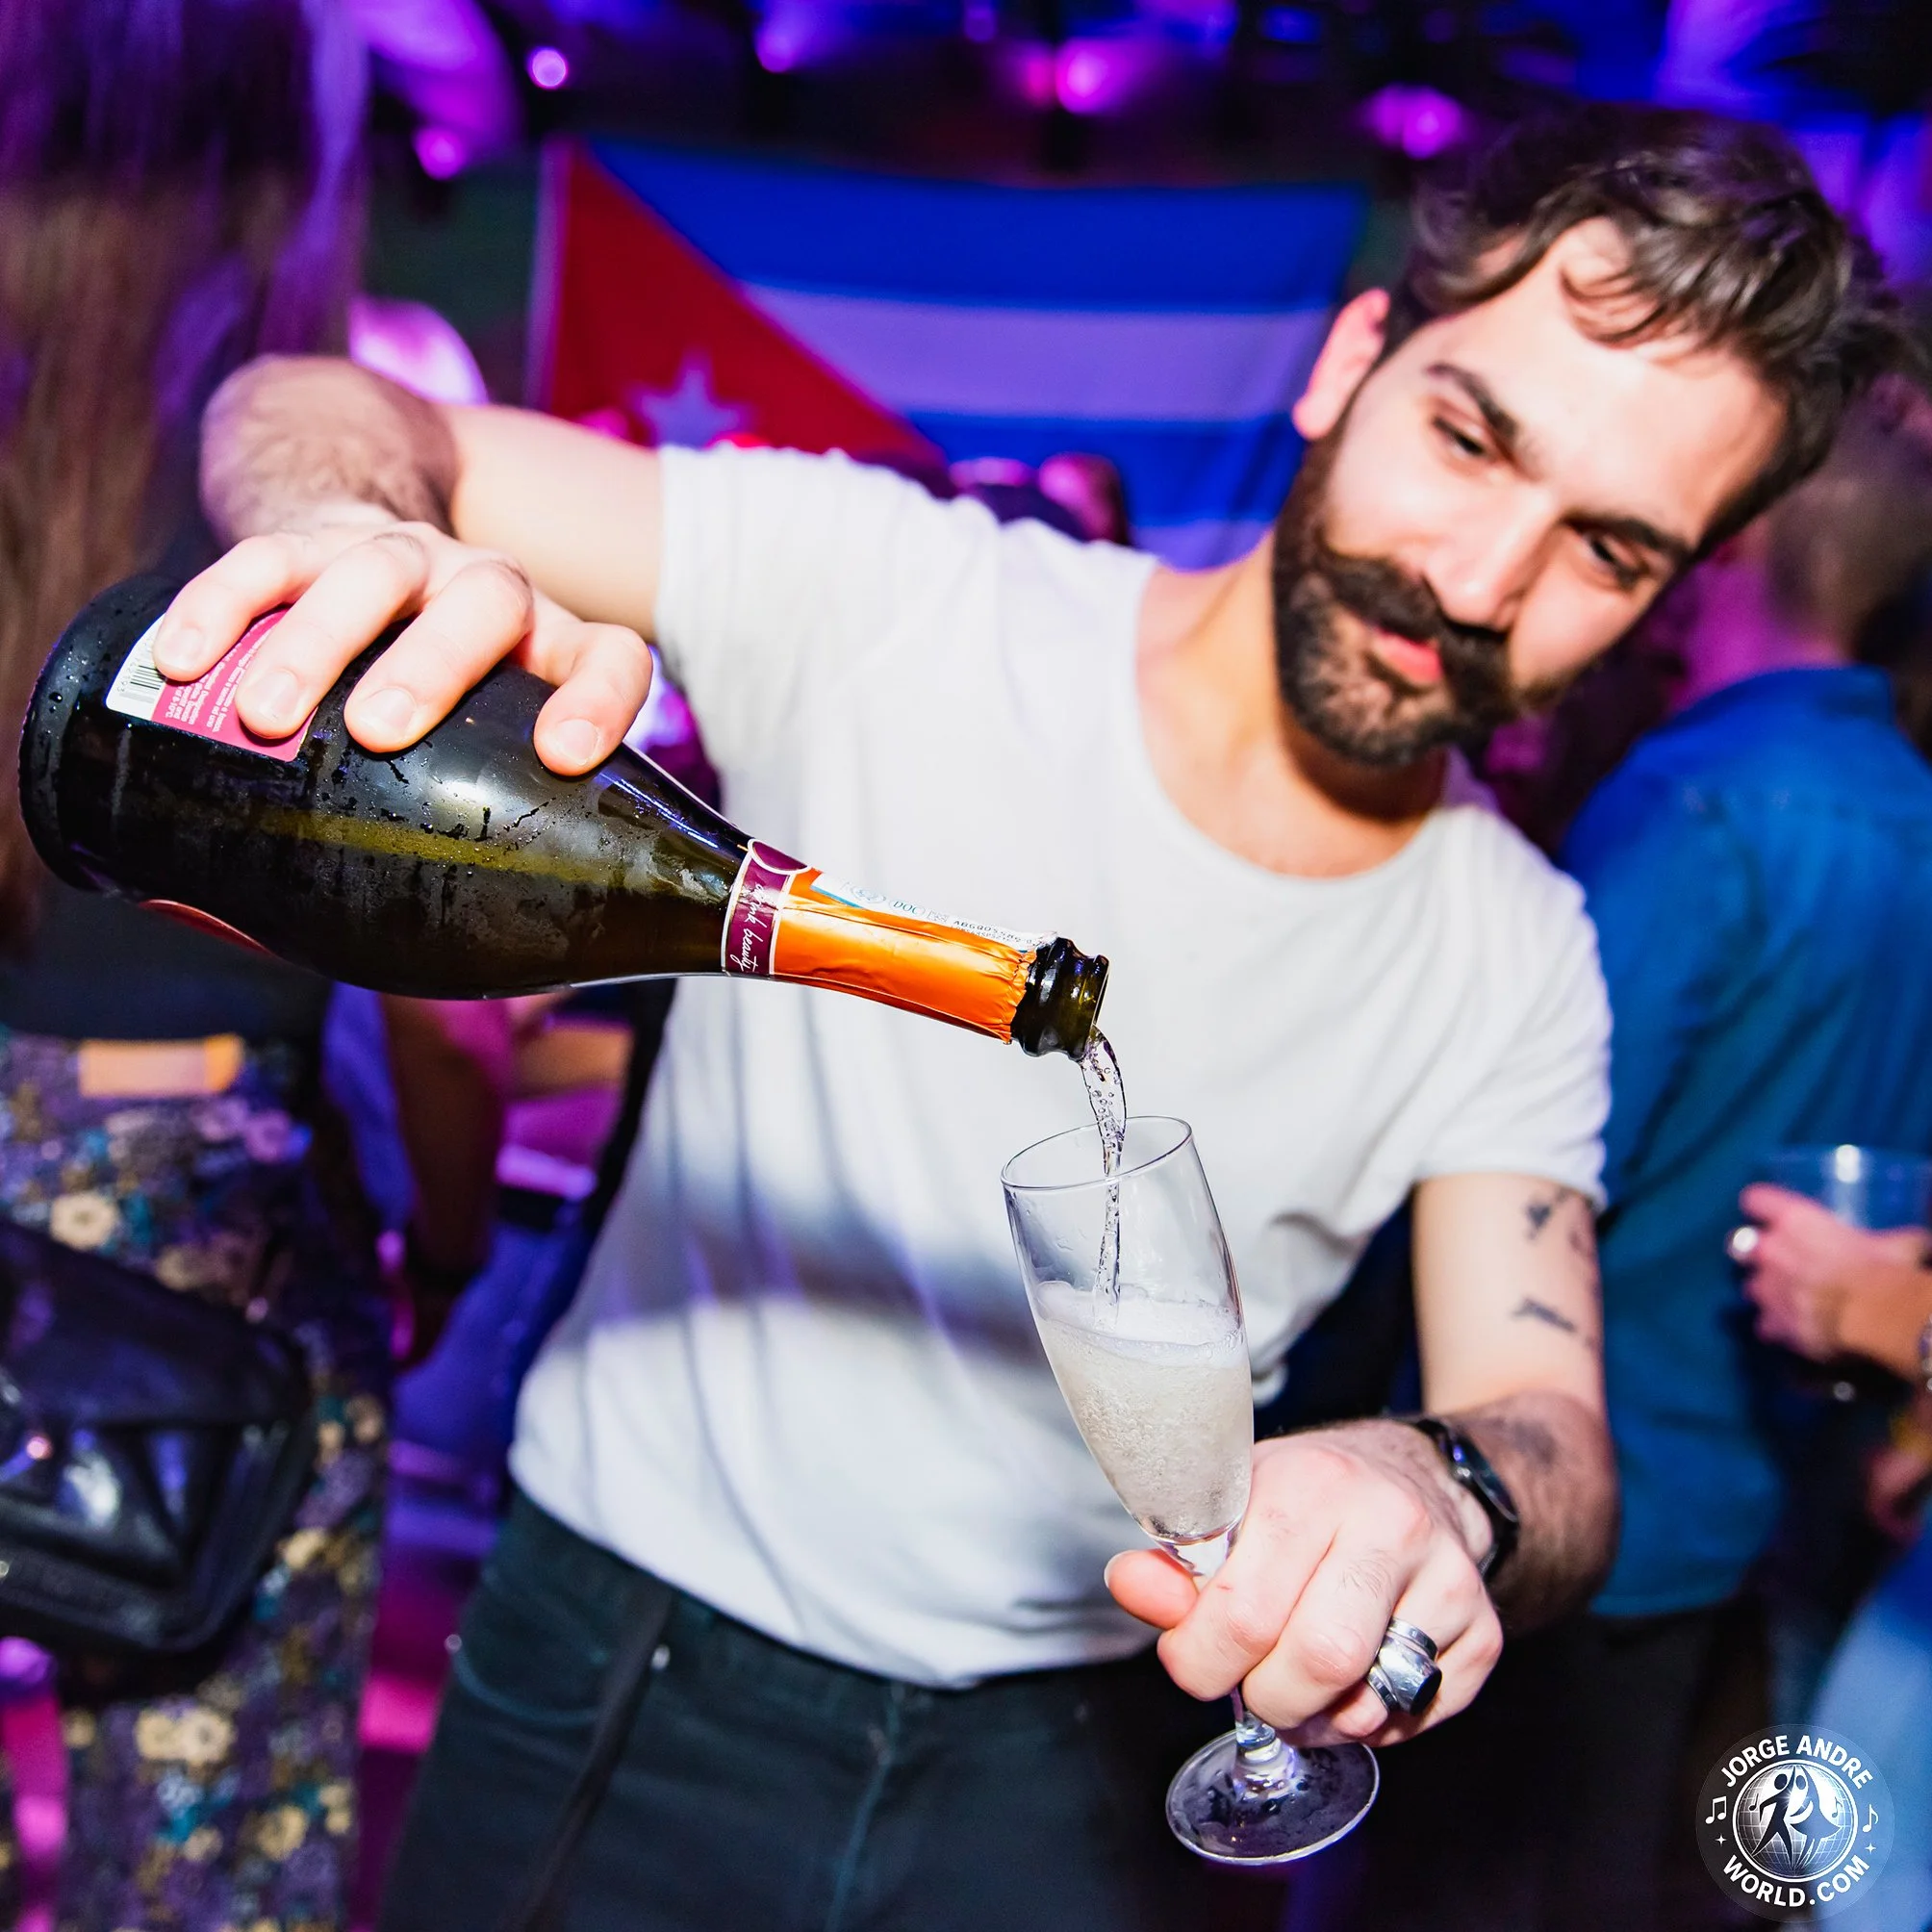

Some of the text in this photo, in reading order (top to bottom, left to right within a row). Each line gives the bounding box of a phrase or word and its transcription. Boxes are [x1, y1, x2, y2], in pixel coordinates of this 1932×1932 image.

[729, 883, 768, 972] drink beauty
[893, 901, 921, 915] DOC
